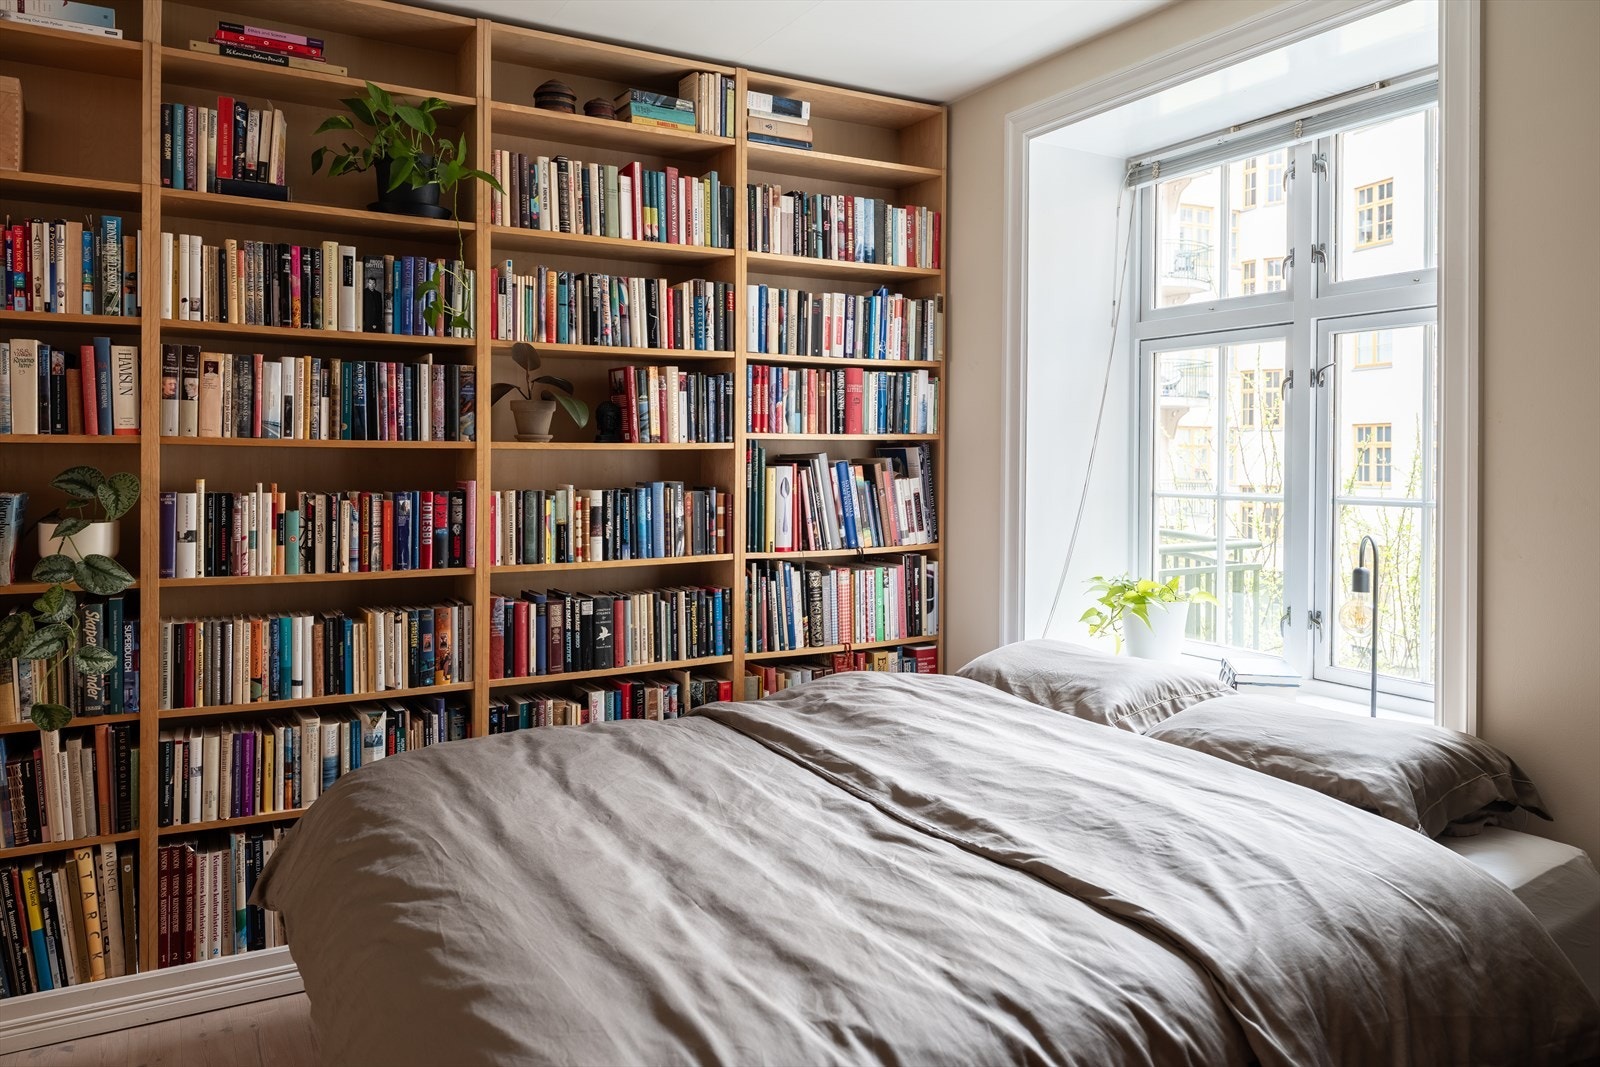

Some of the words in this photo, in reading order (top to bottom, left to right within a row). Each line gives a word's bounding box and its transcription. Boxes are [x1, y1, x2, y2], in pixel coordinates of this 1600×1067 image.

[15, 237, 23, 249] New
[84, 246, 92, 263] Sicily
[15, 249, 23, 262] York
[15, 262, 23, 272] City
[118, 352, 134, 397] HAMSUN
[422, 501, 432, 512] JO
[422, 513, 432, 545] NESBØ
[124, 625, 133, 673] SUPERDUTCH
[119, 732, 127, 797] HUSBYGGING
[27, 876, 35, 891] Paul
[105, 851, 117, 892] MUNCH
[1, 872, 12, 898] Anatomi
[9, 910, 18, 940] kunstnere
[30, 890, 38, 907] Rand
[77, 851, 102, 960] STARCK
